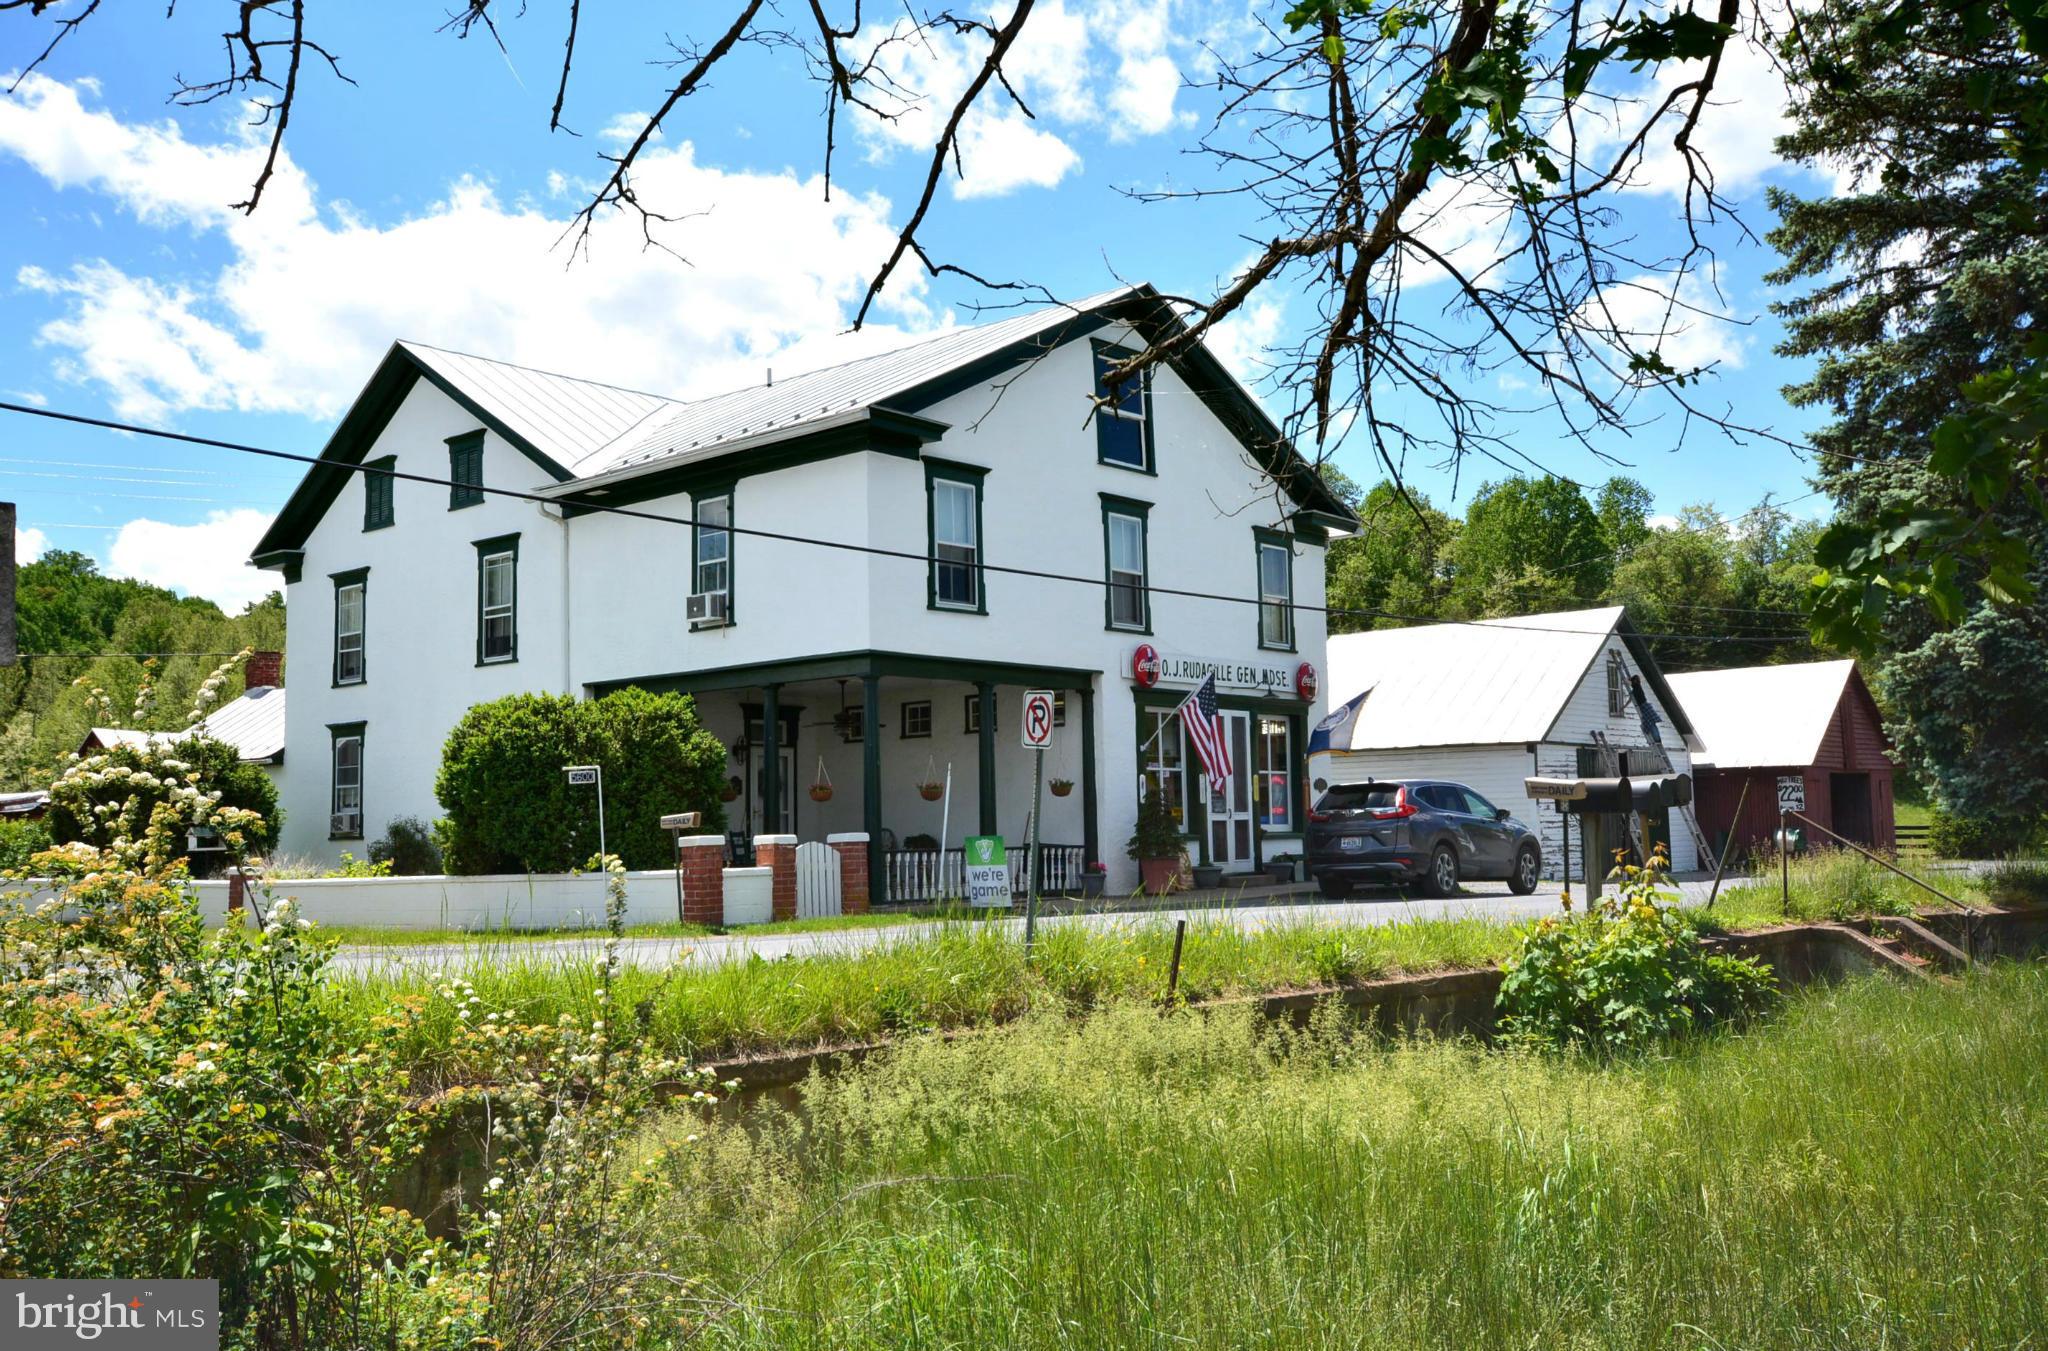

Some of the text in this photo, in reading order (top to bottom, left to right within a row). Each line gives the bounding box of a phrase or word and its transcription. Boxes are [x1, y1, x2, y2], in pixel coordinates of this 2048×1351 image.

[1548, 785, 1575, 796] DAILY
[672, 817, 691, 826] DAILY
[972, 867, 1004, 882] we're
[971, 885, 1008, 900] game
